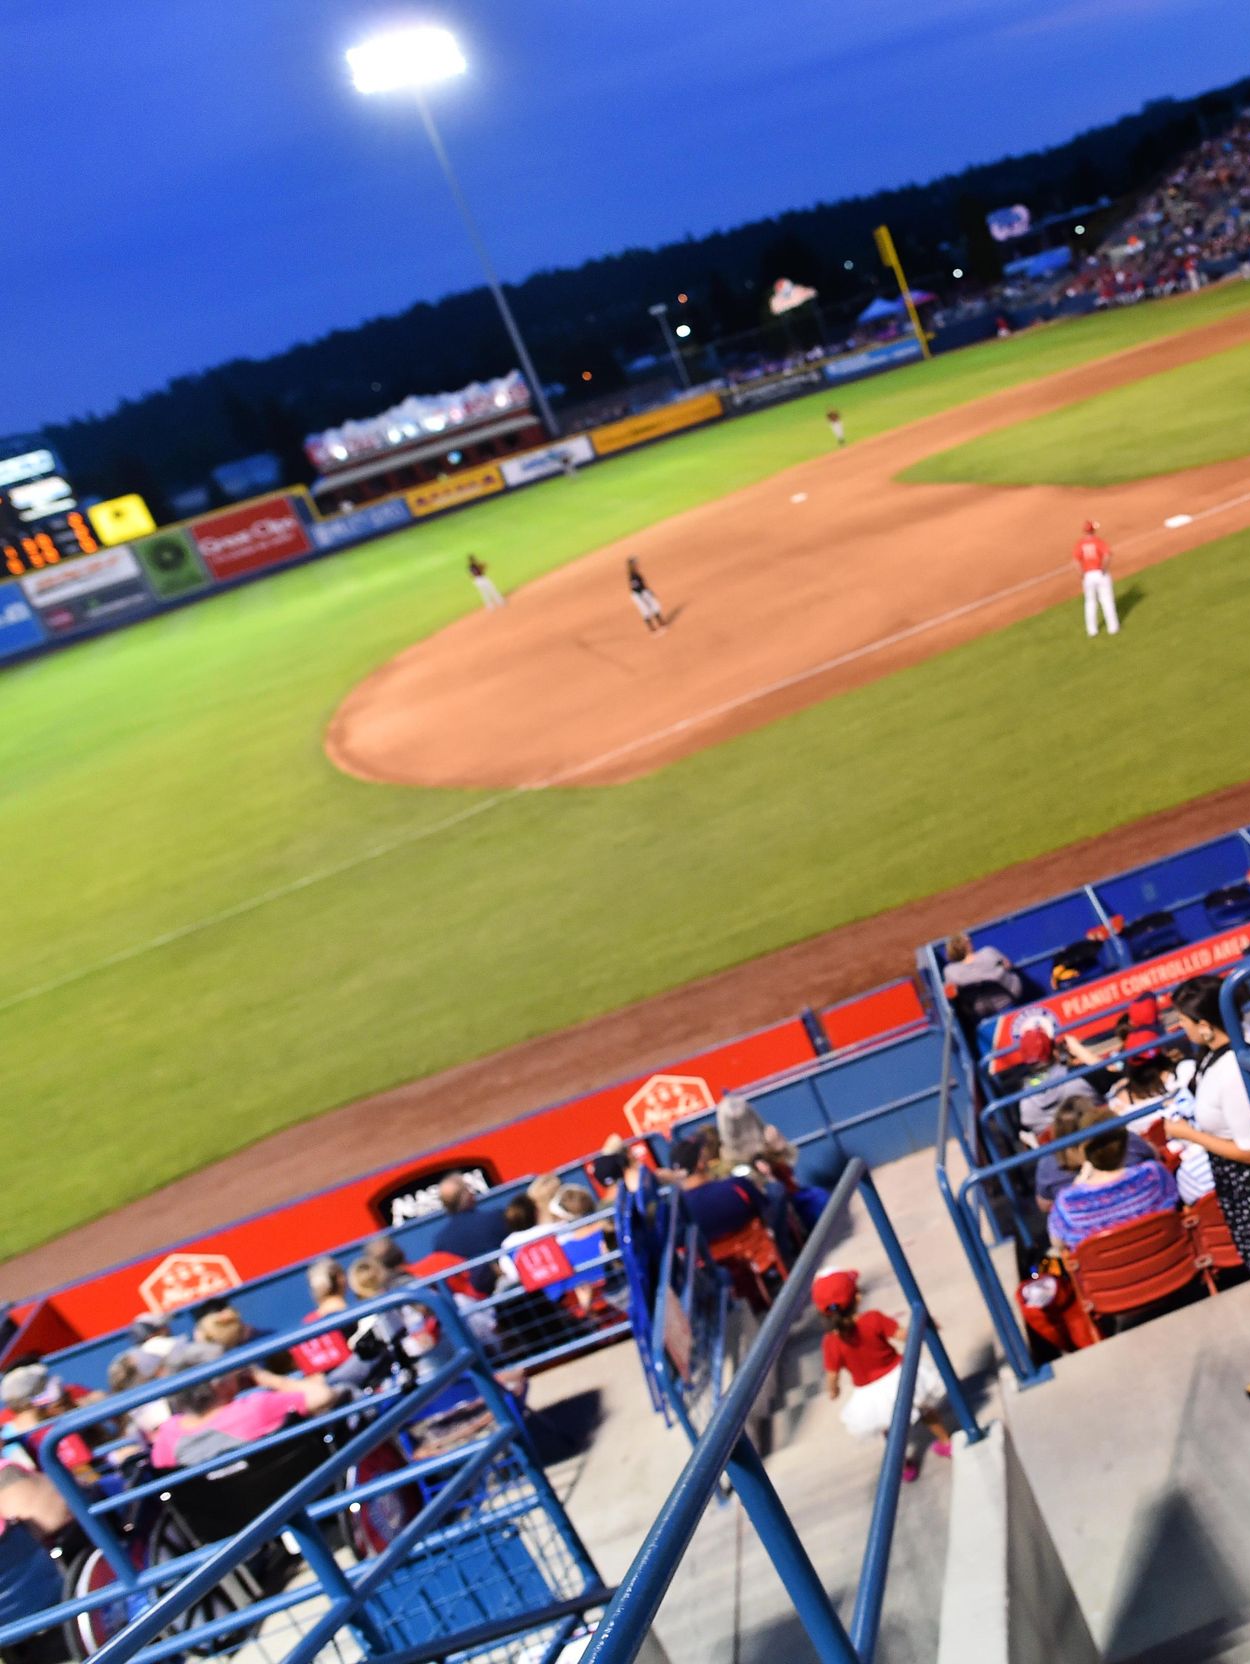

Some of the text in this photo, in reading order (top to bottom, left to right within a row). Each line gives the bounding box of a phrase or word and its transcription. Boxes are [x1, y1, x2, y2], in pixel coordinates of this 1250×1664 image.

[1060, 935, 1250, 1019] PEANUT CONTROLLED AREA
